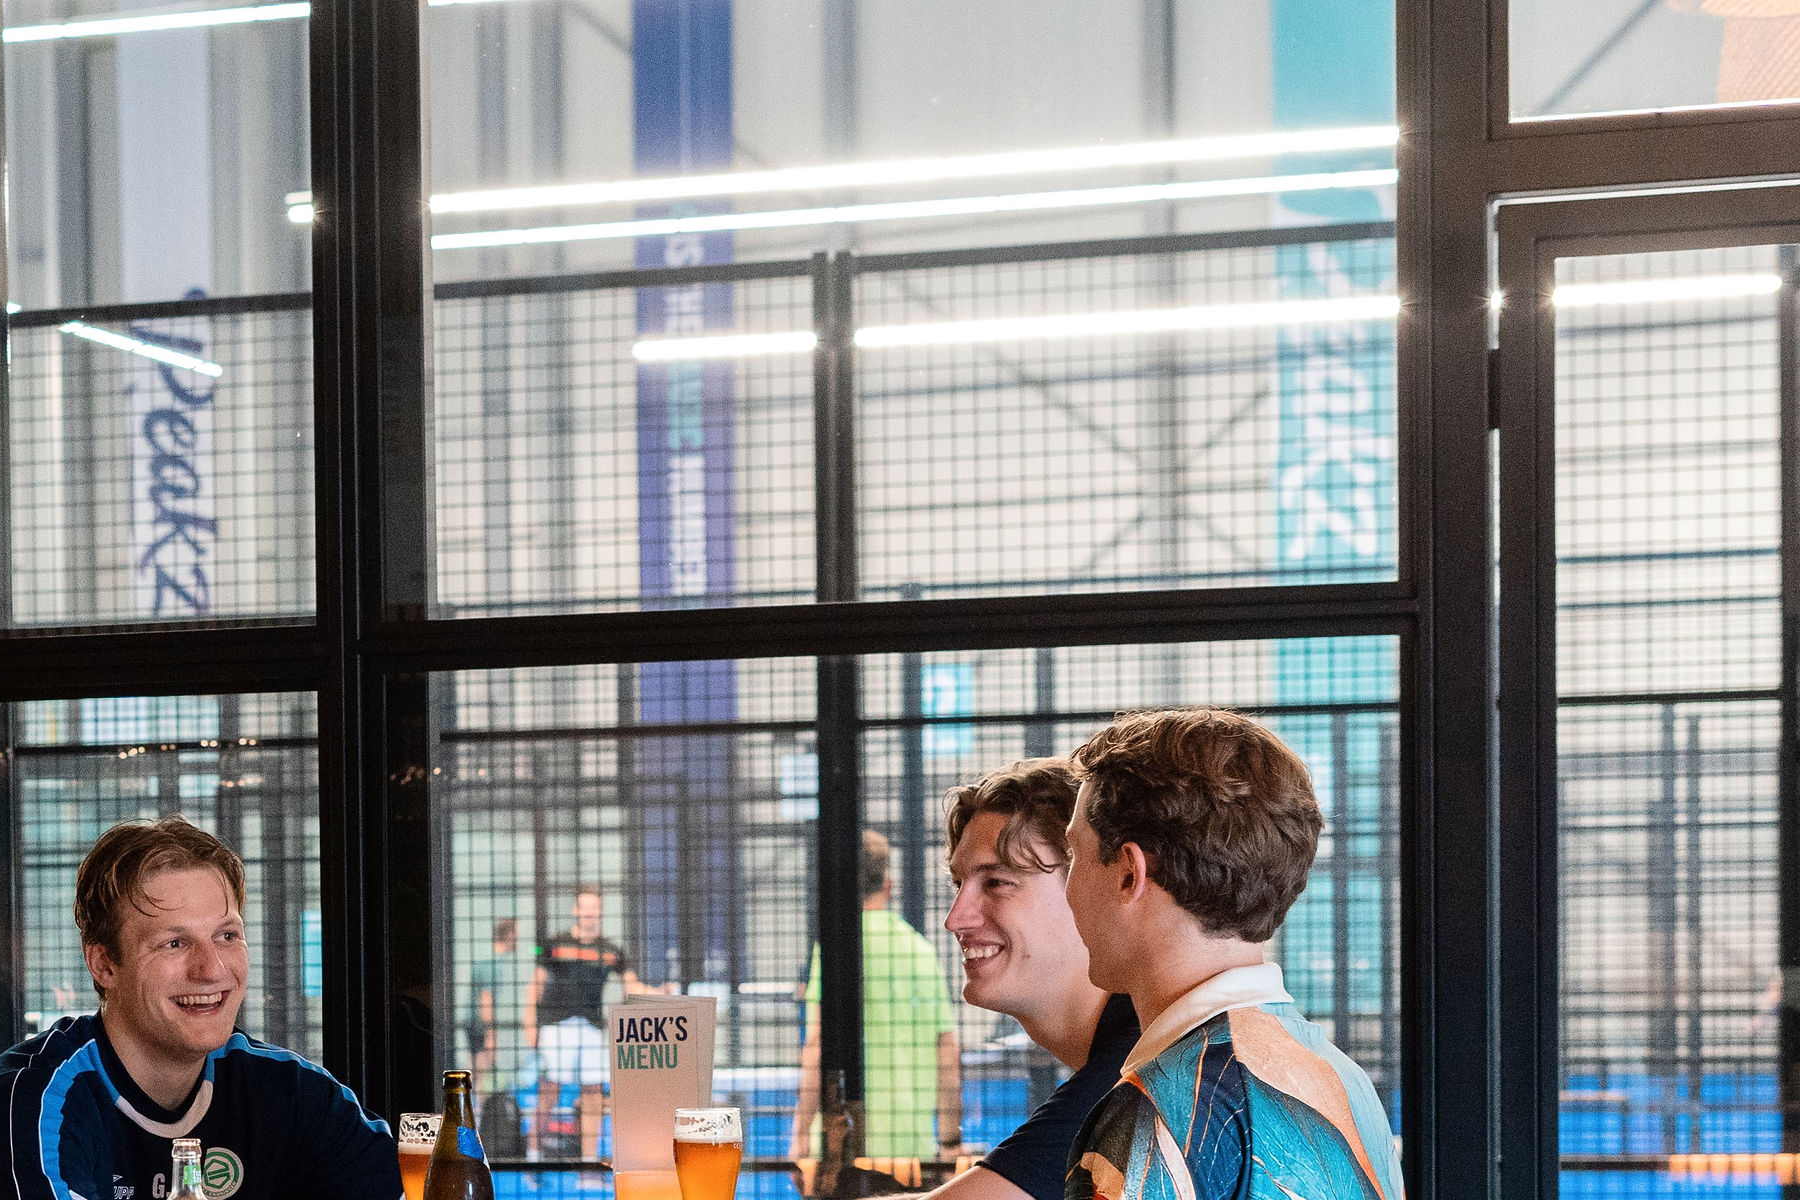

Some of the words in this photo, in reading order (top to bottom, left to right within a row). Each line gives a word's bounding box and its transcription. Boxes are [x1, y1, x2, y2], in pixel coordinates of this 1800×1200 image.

[129, 287, 221, 617] Peakz
[616, 1015, 688, 1043] JACK'S
[617, 1044, 678, 1070] MENU
